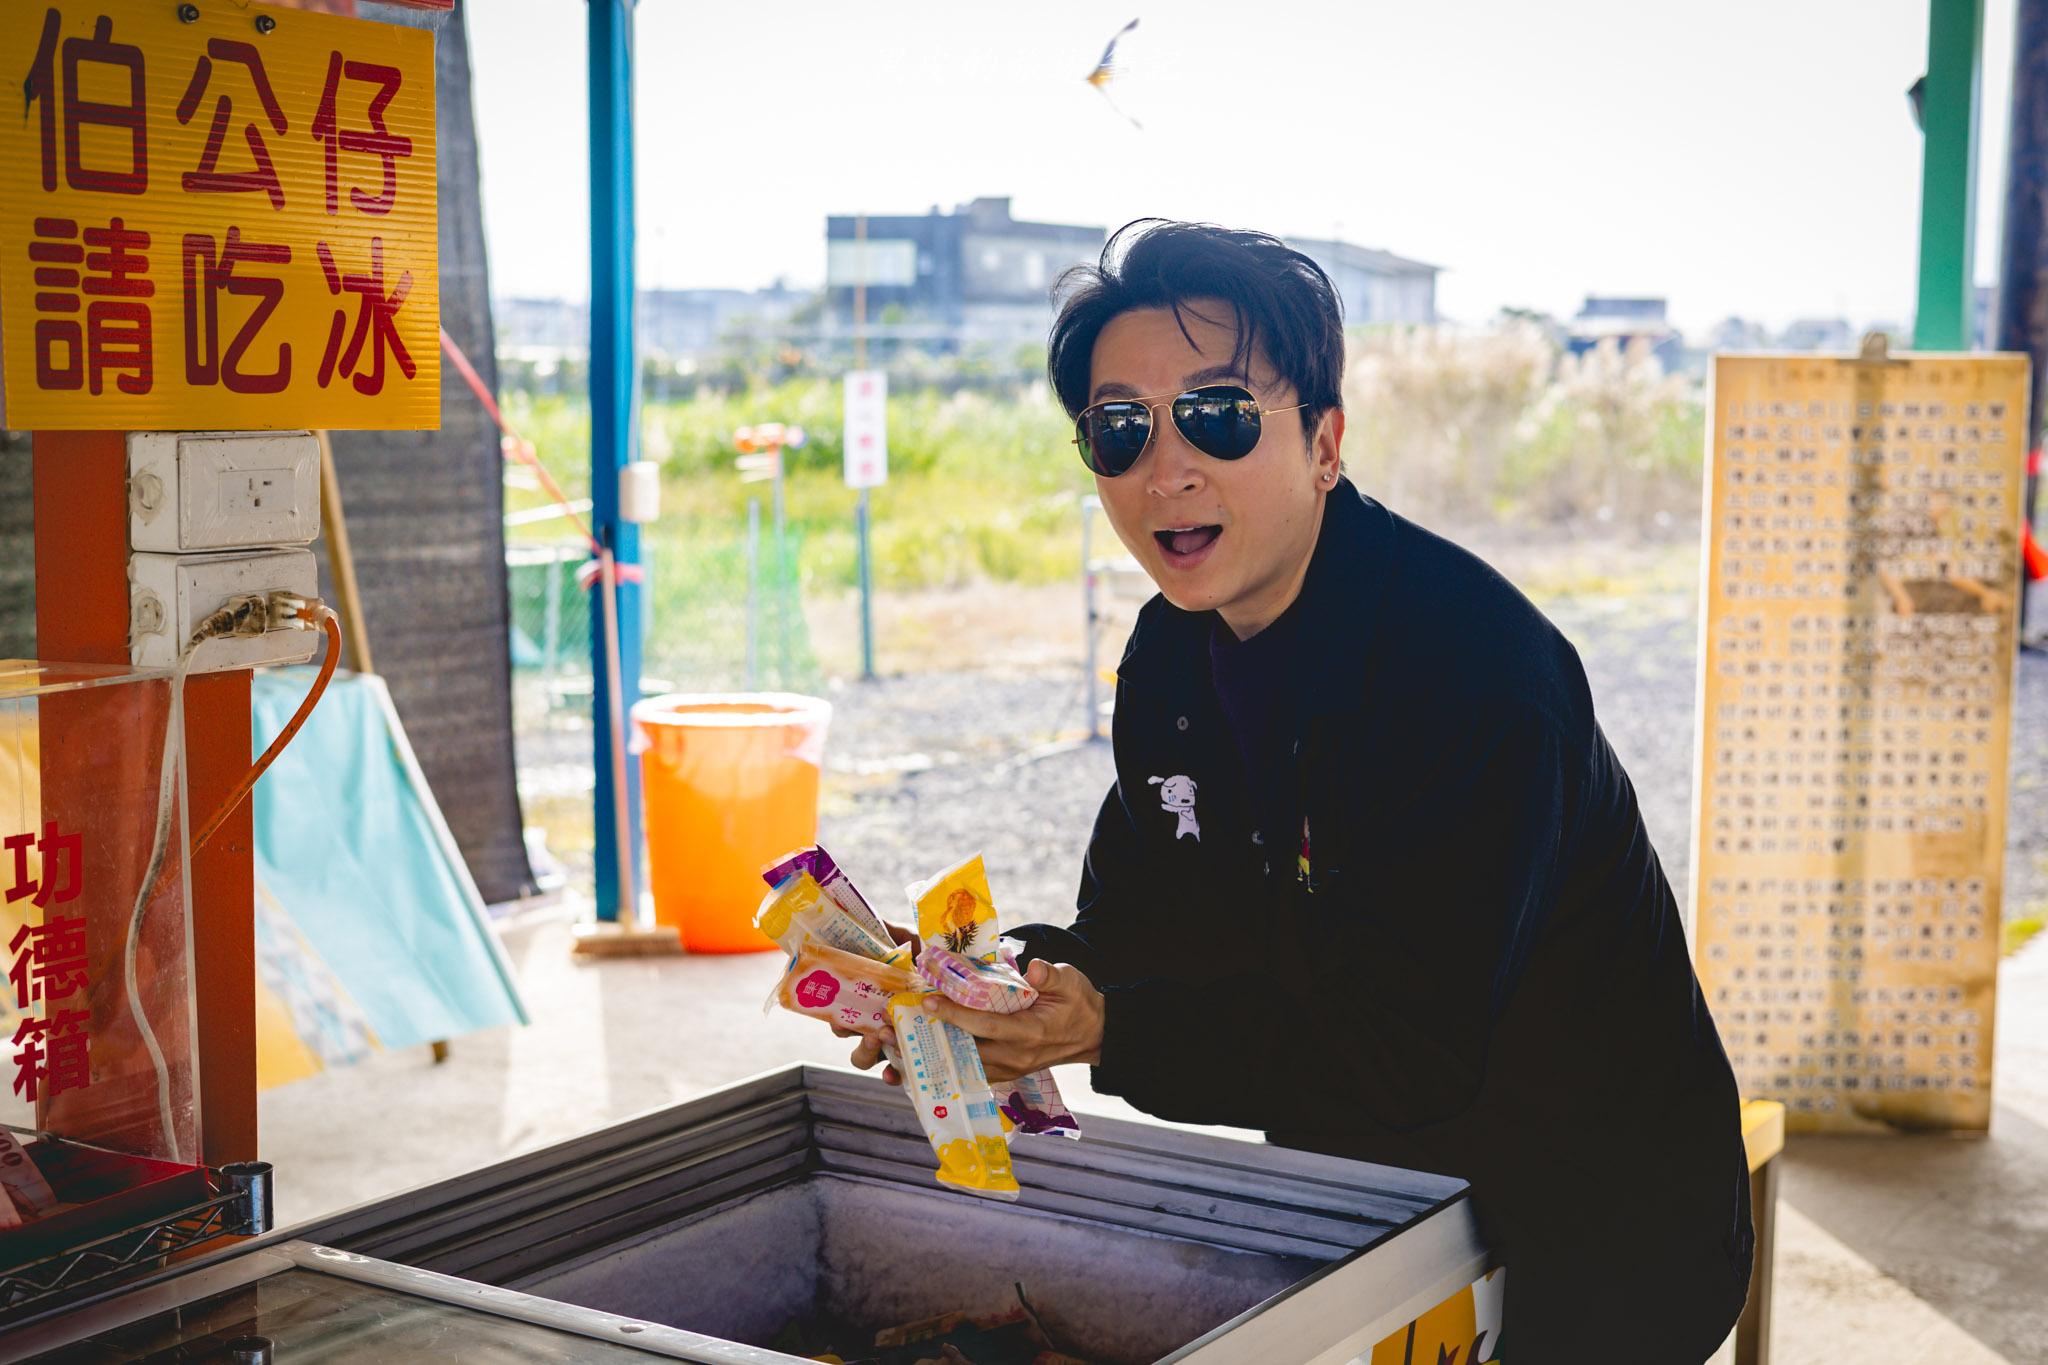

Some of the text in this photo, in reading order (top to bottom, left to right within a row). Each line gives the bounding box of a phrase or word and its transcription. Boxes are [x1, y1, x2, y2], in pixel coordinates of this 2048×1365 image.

[24, 7, 413, 216] 伯公仔
[28, 217, 417, 396] 請吃冰
[4, 821, 91, 1103] 功德箱
